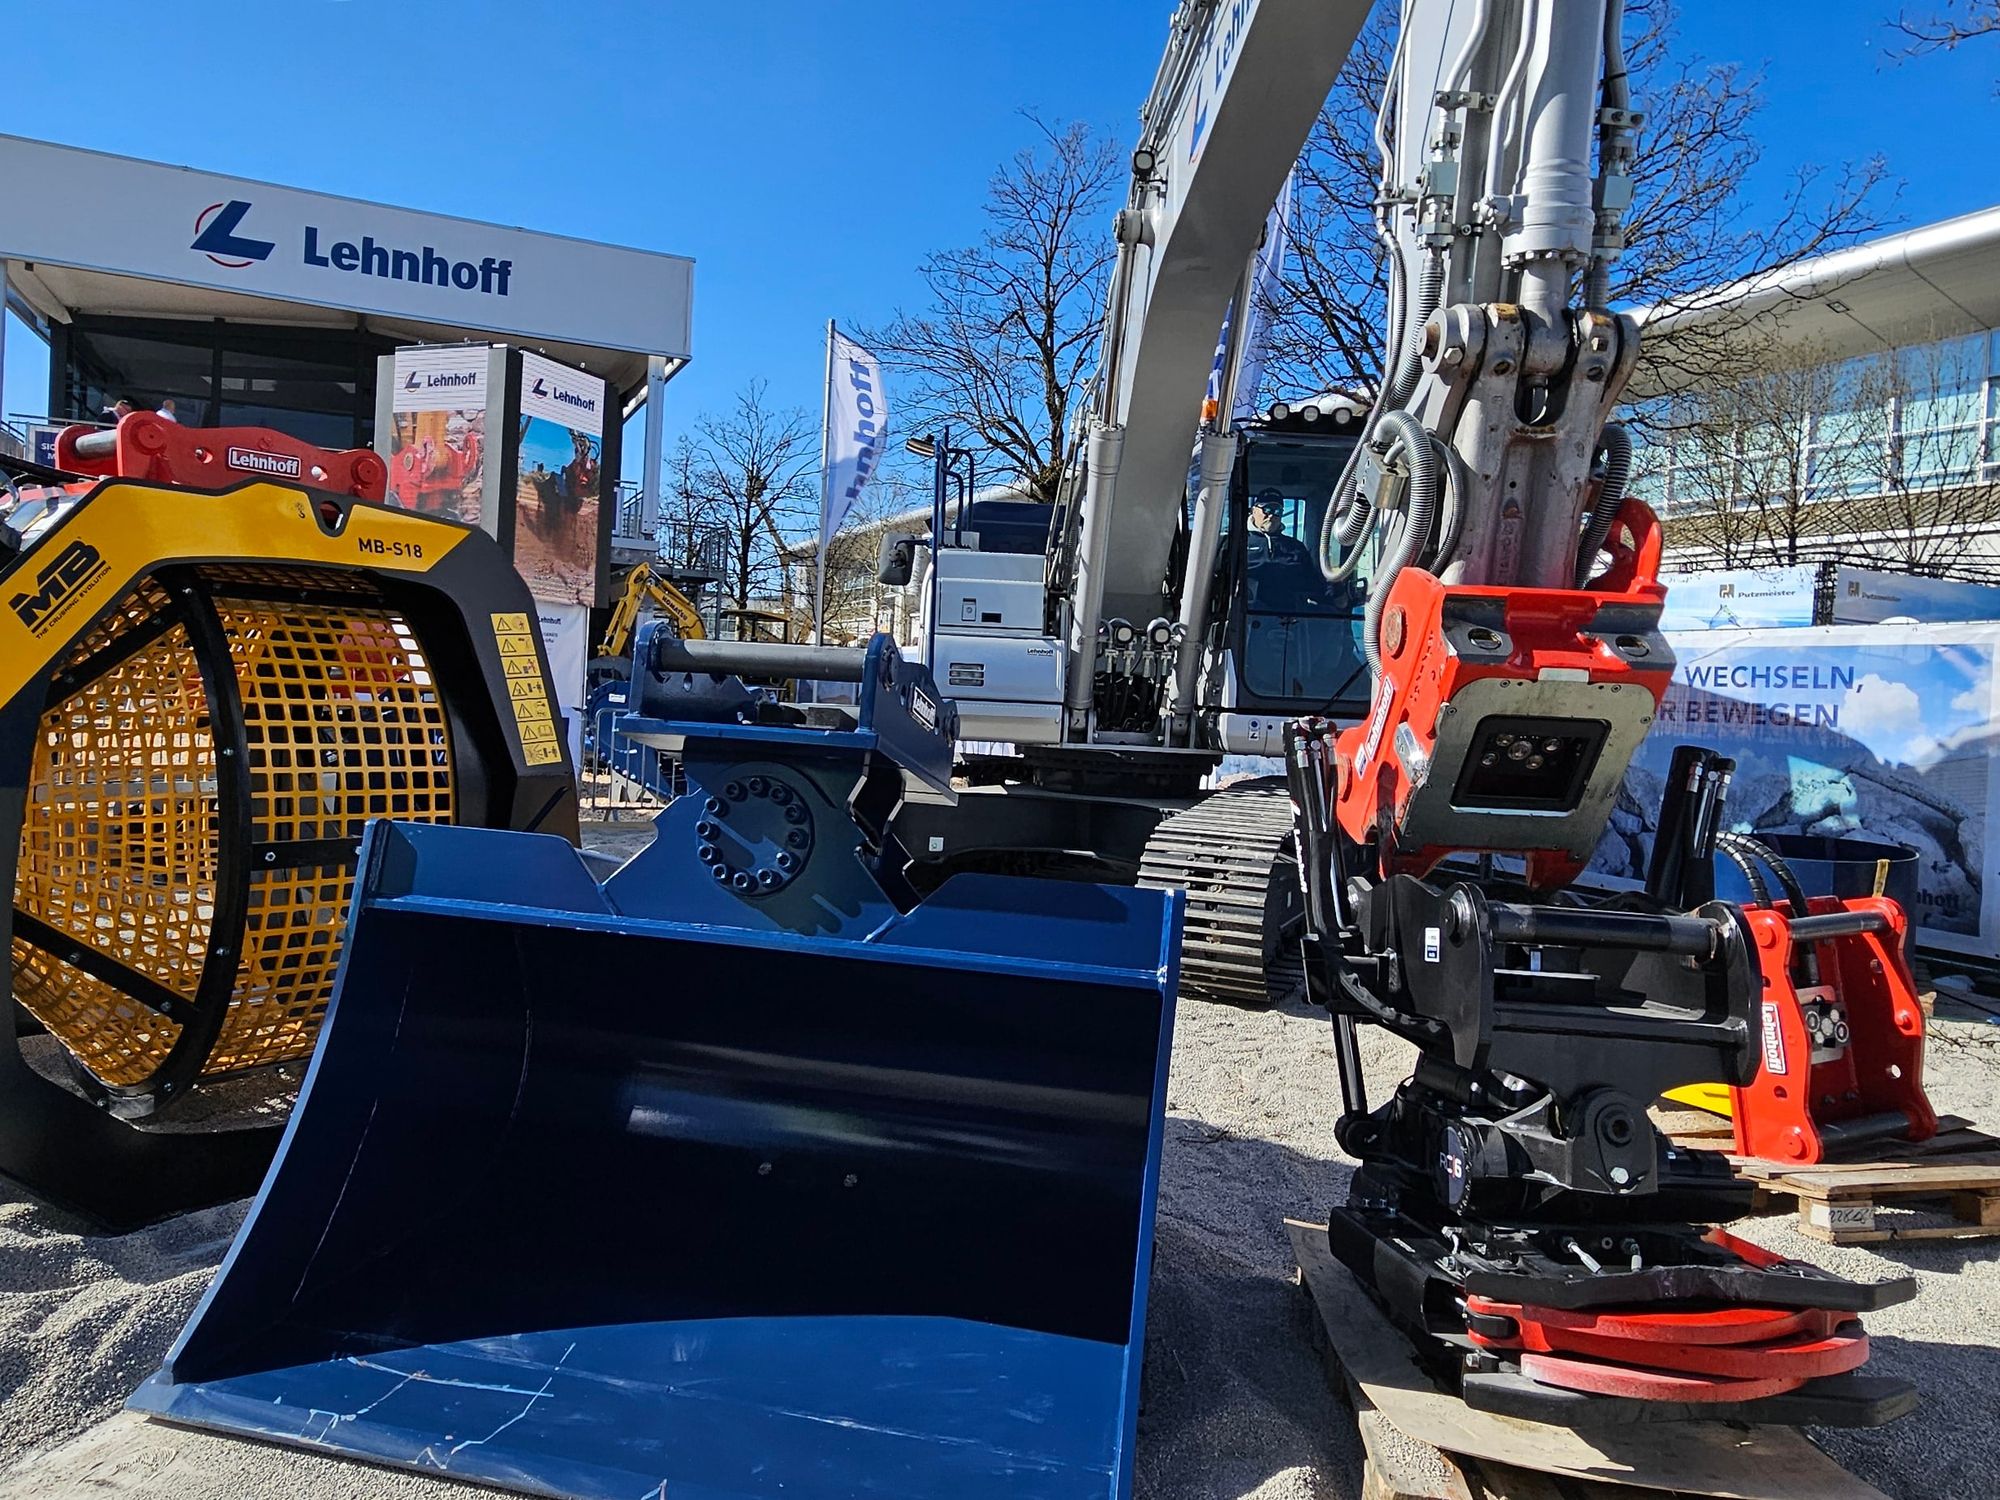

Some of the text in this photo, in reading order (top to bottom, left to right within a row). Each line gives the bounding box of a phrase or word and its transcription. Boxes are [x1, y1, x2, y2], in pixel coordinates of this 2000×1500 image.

[303, 226, 513, 296] Lehnhoff
[427, 372, 477, 388] Lehnhoff
[553, 387, 596, 412] Lehnhoff
[231, 450, 299, 475] Lehnhoff
[358, 537, 423, 559] MB-S18
[8, 540, 100, 628] MB
[48, 597, 80, 628] CRUSHING
[78, 565, 112, 599] EVOLUTION
[1738, 589, 1797, 599] Putzmeister
[1684, 664, 1865, 694] WECHSELN,
[1685, 700, 1839, 728] BEWEGEN
[1761, 1004, 1783, 1071] Lehnhoff
